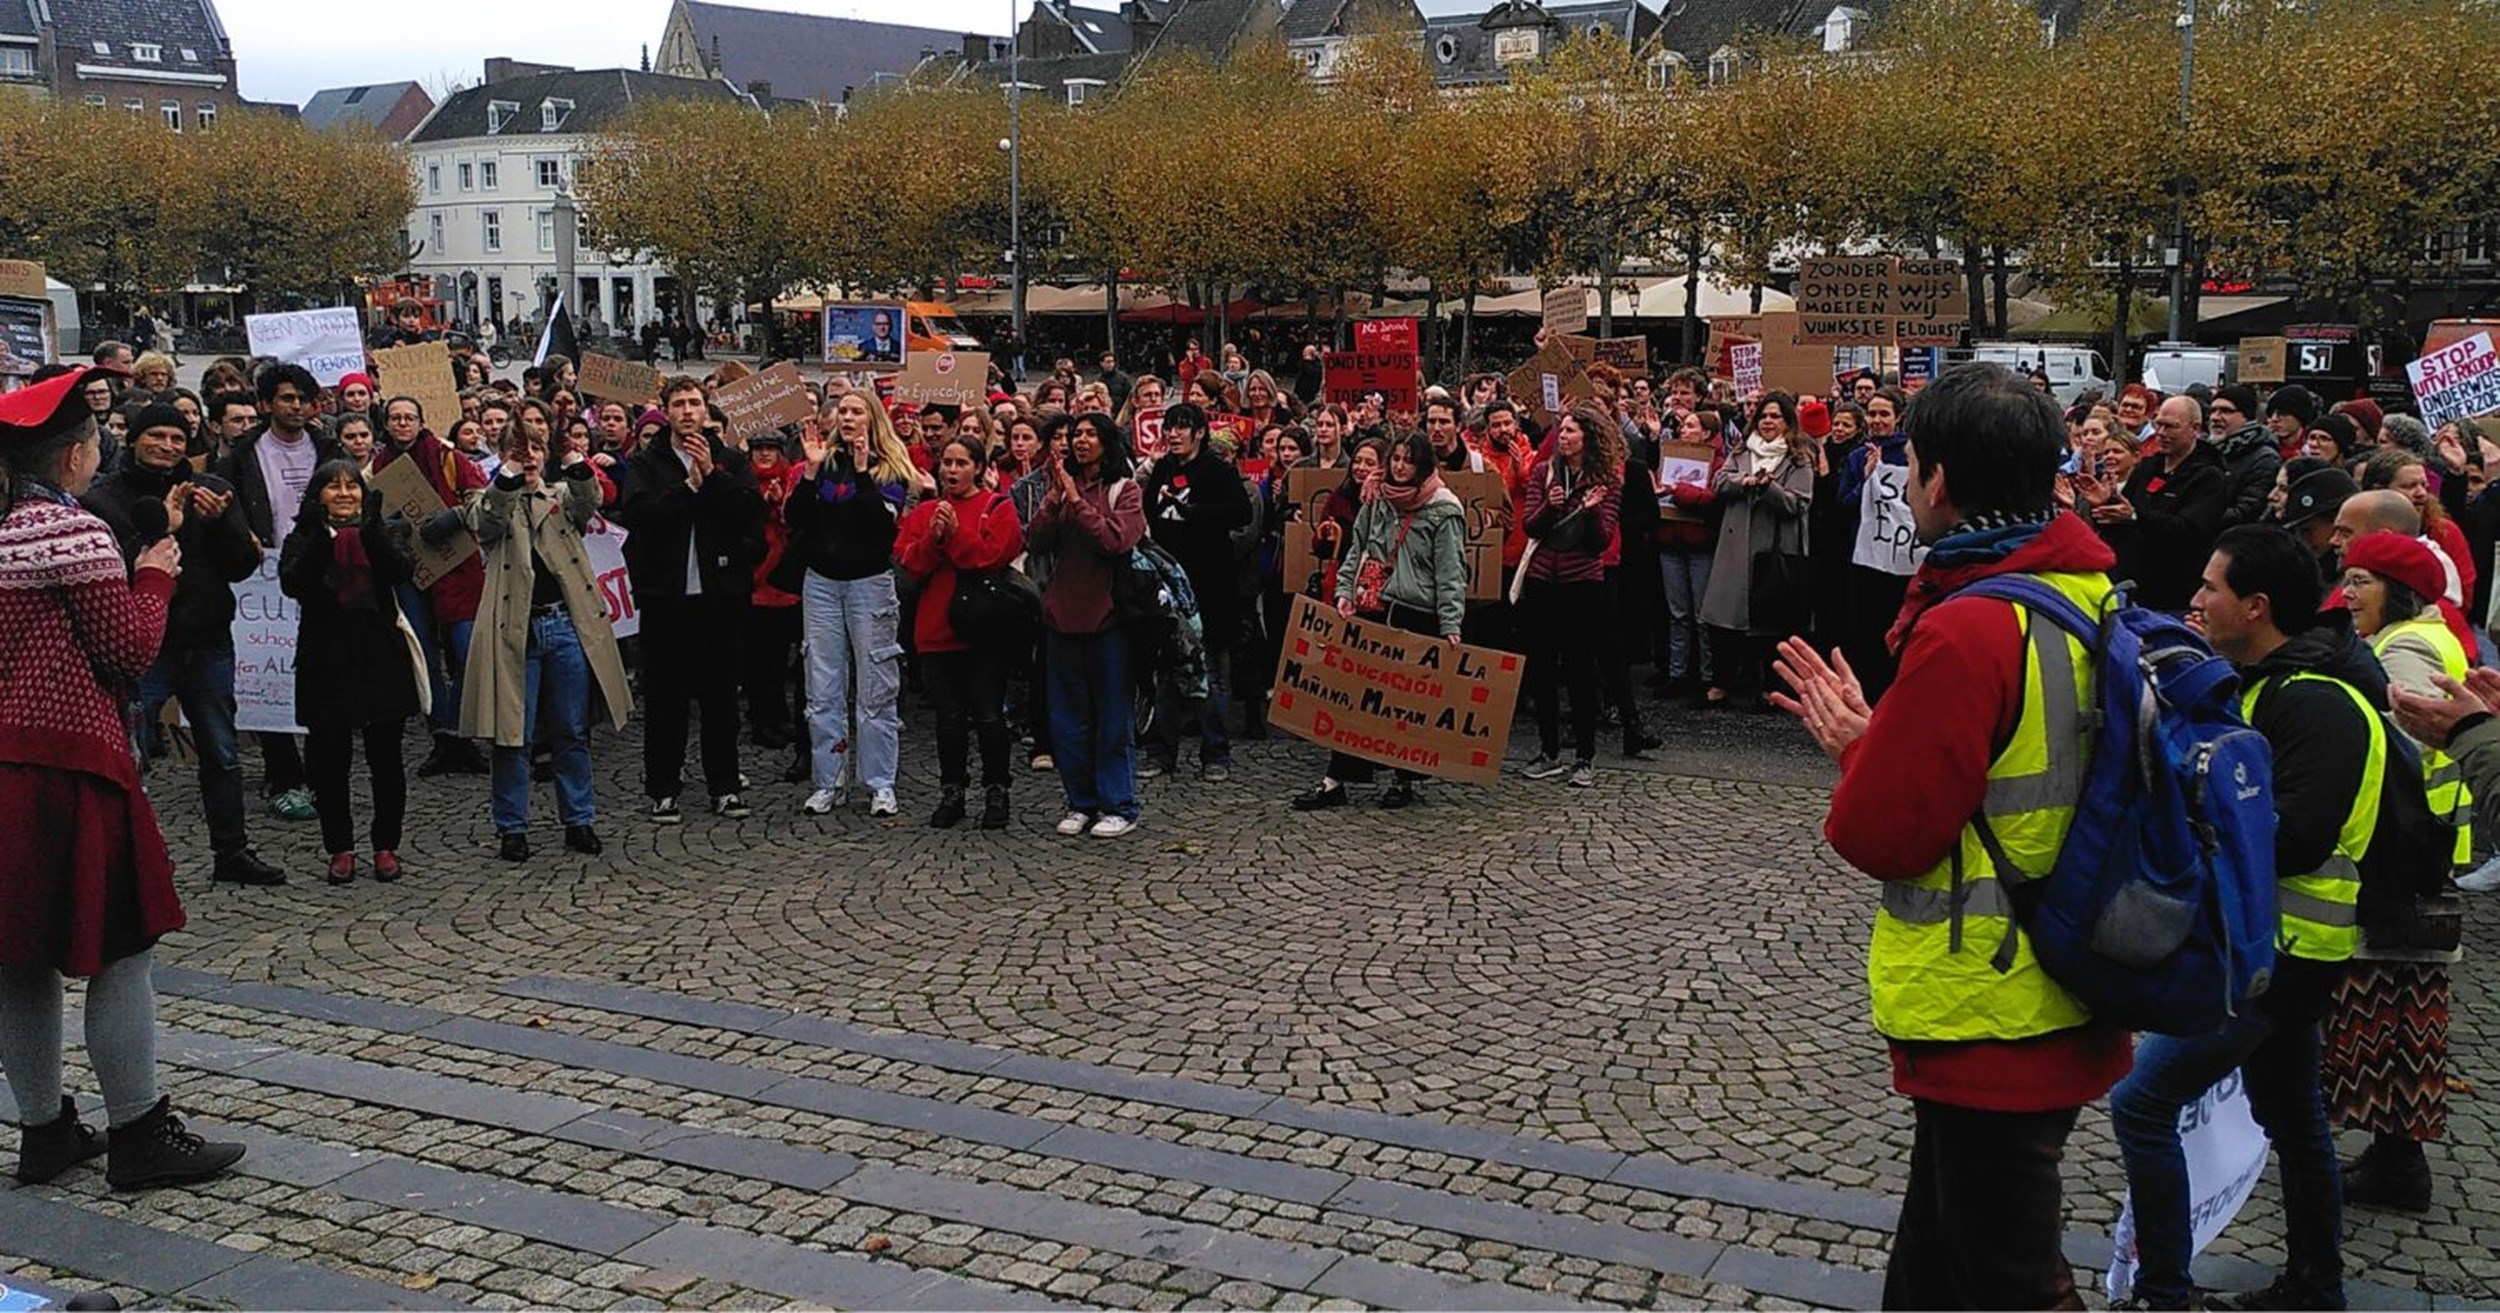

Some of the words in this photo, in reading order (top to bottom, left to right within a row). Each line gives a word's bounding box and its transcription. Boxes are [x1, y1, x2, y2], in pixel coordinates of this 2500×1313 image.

[1807, 262, 1888, 279] ZONDER
[1899, 262, 1957, 275] HOGER
[1805, 283, 1889, 298] ONDER
[2420, 341, 2477, 377] STOP
[2413, 351, 2497, 398] UITVERKOOP
[2427, 386, 2500, 431] ONDERZOE
[249, 626, 297, 649] schoo
[1418, 645, 1441, 669] A
[1435, 707, 1456, 731] A
